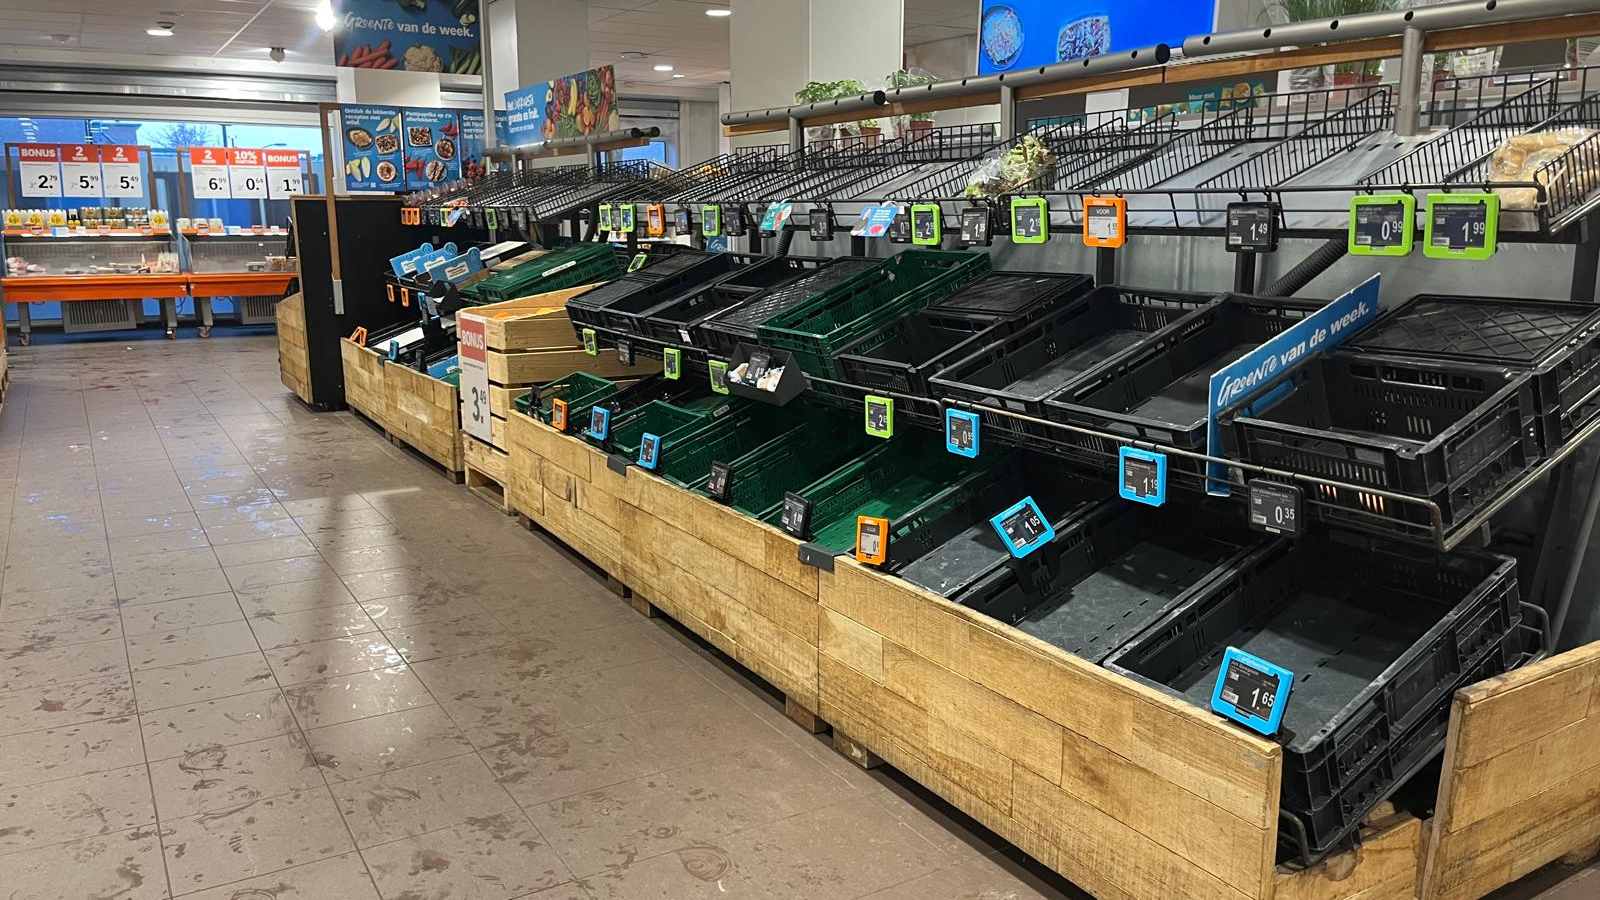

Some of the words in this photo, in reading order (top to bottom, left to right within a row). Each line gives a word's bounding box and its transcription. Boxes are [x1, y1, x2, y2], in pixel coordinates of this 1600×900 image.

[397, 22, 418, 33] van
[422, 23, 436, 34] de
[439, 26, 474, 37] week.
[21, 149, 56, 157] BONUS
[75, 146, 83, 156] 2
[115, 147, 124, 157] 2
[204, 150, 212, 159] 2
[234, 150, 257, 160] 10%
[268, 155, 298, 163] BONUS
[79, 175, 99, 189] 5.99
[1250, 223, 1268, 241] 1.49
[1381, 220, 1403, 240] 0.99
[1461, 221, 1485, 242] 1.99
[461, 329, 484, 350] BONUS
[1280, 341, 1306, 366] van
[1309, 329, 1327, 348] de
[1330, 301, 1370, 335] week.
[472, 386, 487, 424] 3.49
[1275, 505, 1295, 525] 0.35
[1024, 515, 1041, 535] 1.05
[1251, 687, 1275, 710] 1.65
